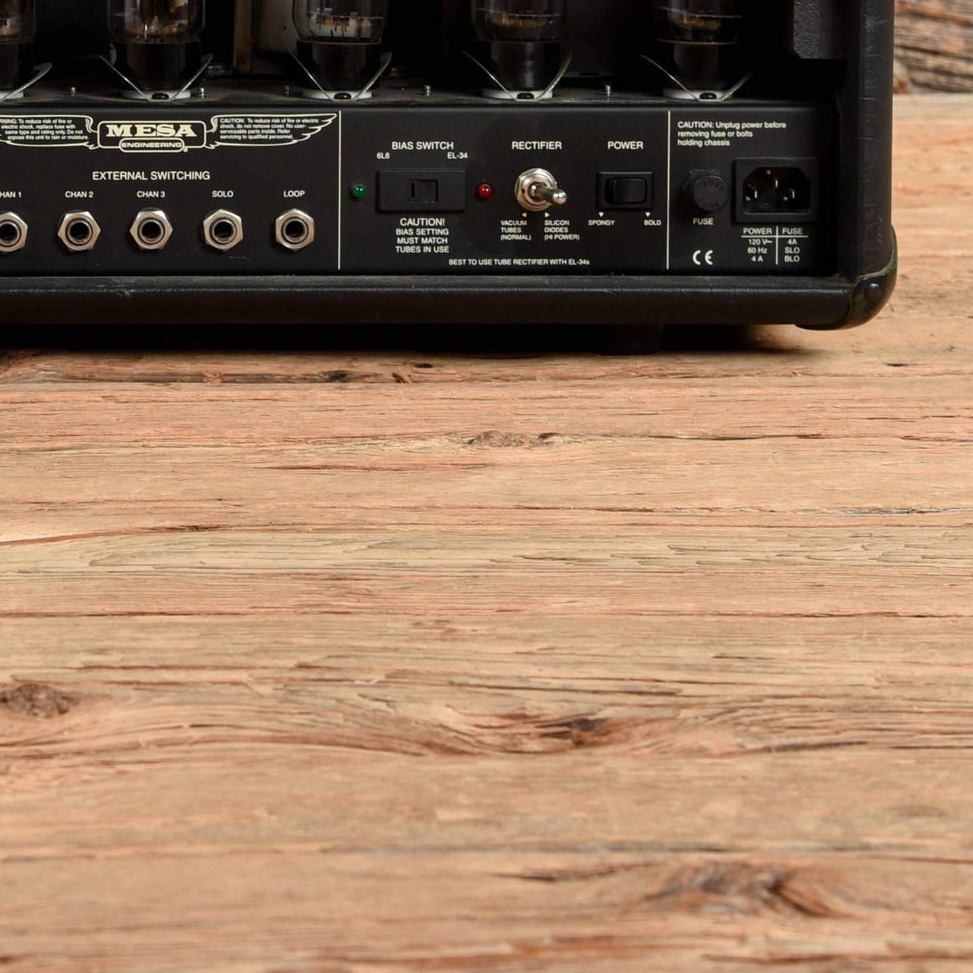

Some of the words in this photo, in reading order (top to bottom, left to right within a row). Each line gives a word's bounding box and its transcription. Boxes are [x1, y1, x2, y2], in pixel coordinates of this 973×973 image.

[106, 124, 197, 137] MESA
[392, 142, 414, 150] BIAS
[416, 142, 454, 150] SWITCH
[512, 141, 562, 150] RECTIFIER
[608, 141, 643, 150] POWER
[92, 171, 147, 181] EXTERNAL
[151, 171, 210, 181] SWITCHING
[400, 218, 445, 226] CAUTION!
